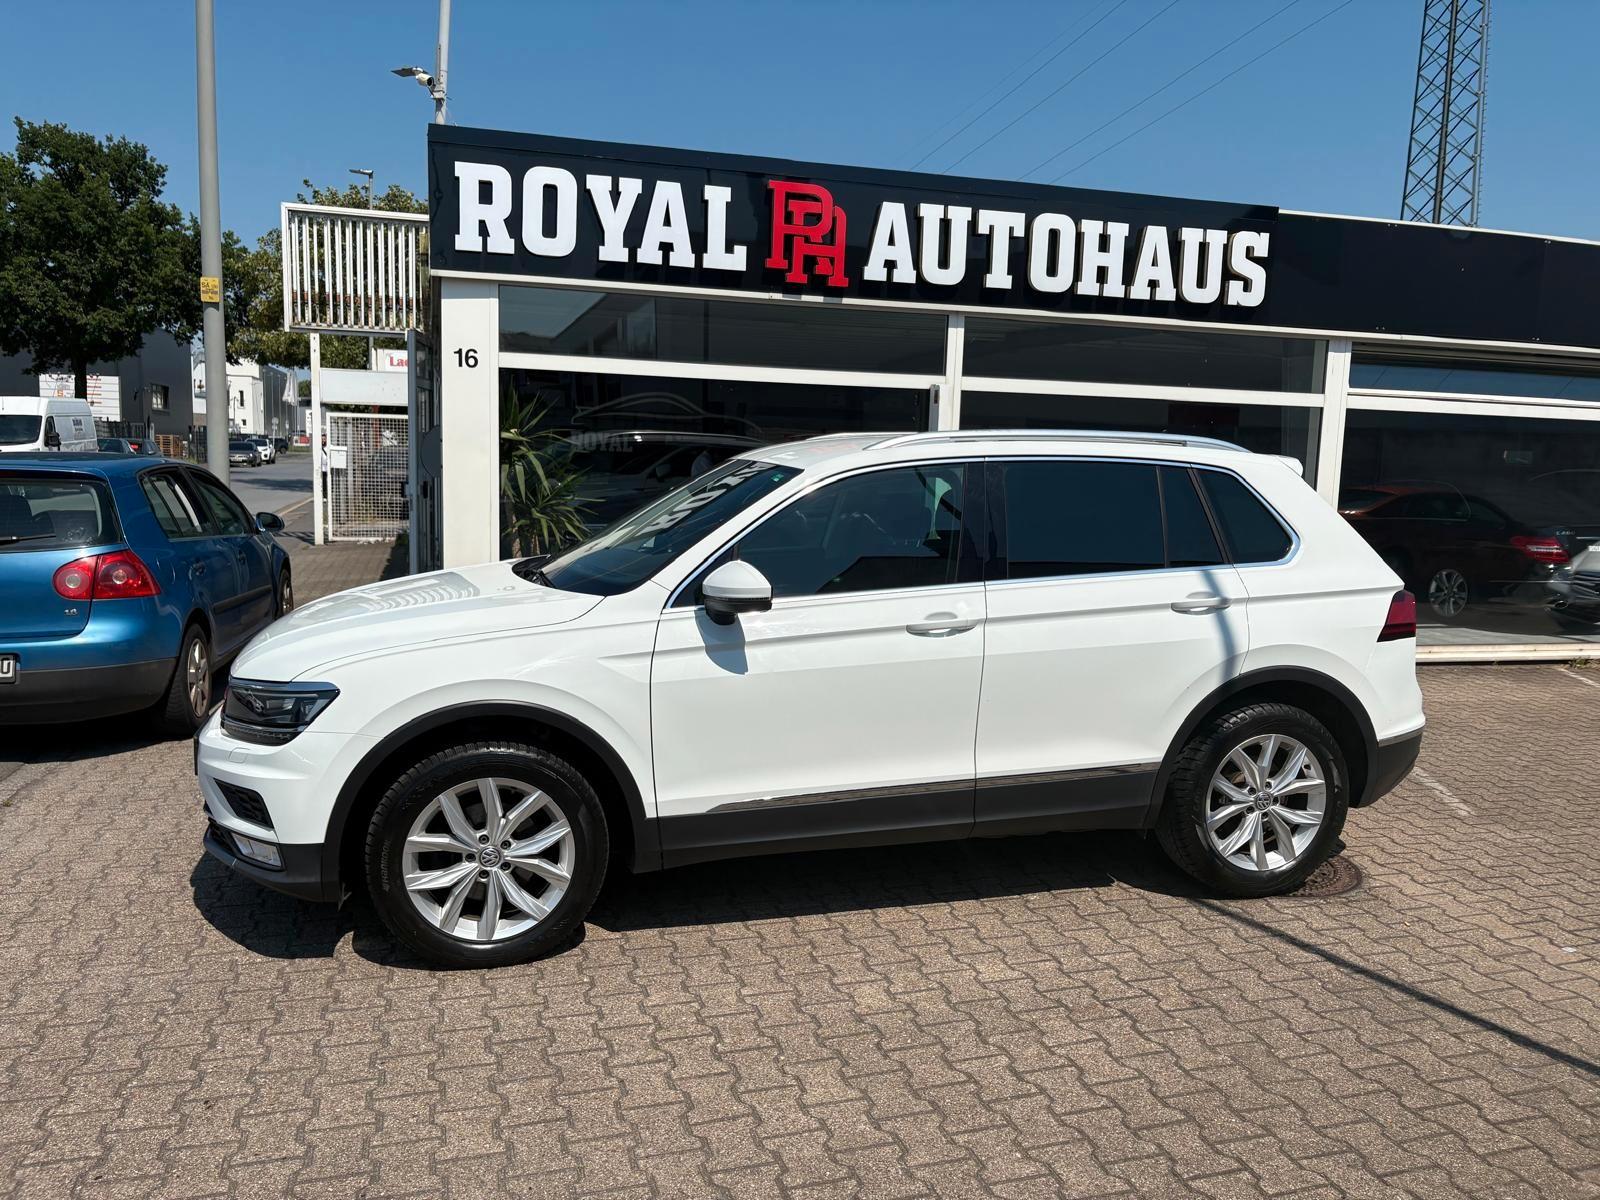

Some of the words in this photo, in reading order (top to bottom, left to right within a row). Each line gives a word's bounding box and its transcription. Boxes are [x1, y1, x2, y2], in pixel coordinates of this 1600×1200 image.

[454, 161, 747, 271] ROYAL
[863, 201, 1270, 307] AUTOHAUS
[453, 348, 479, 368] 16
